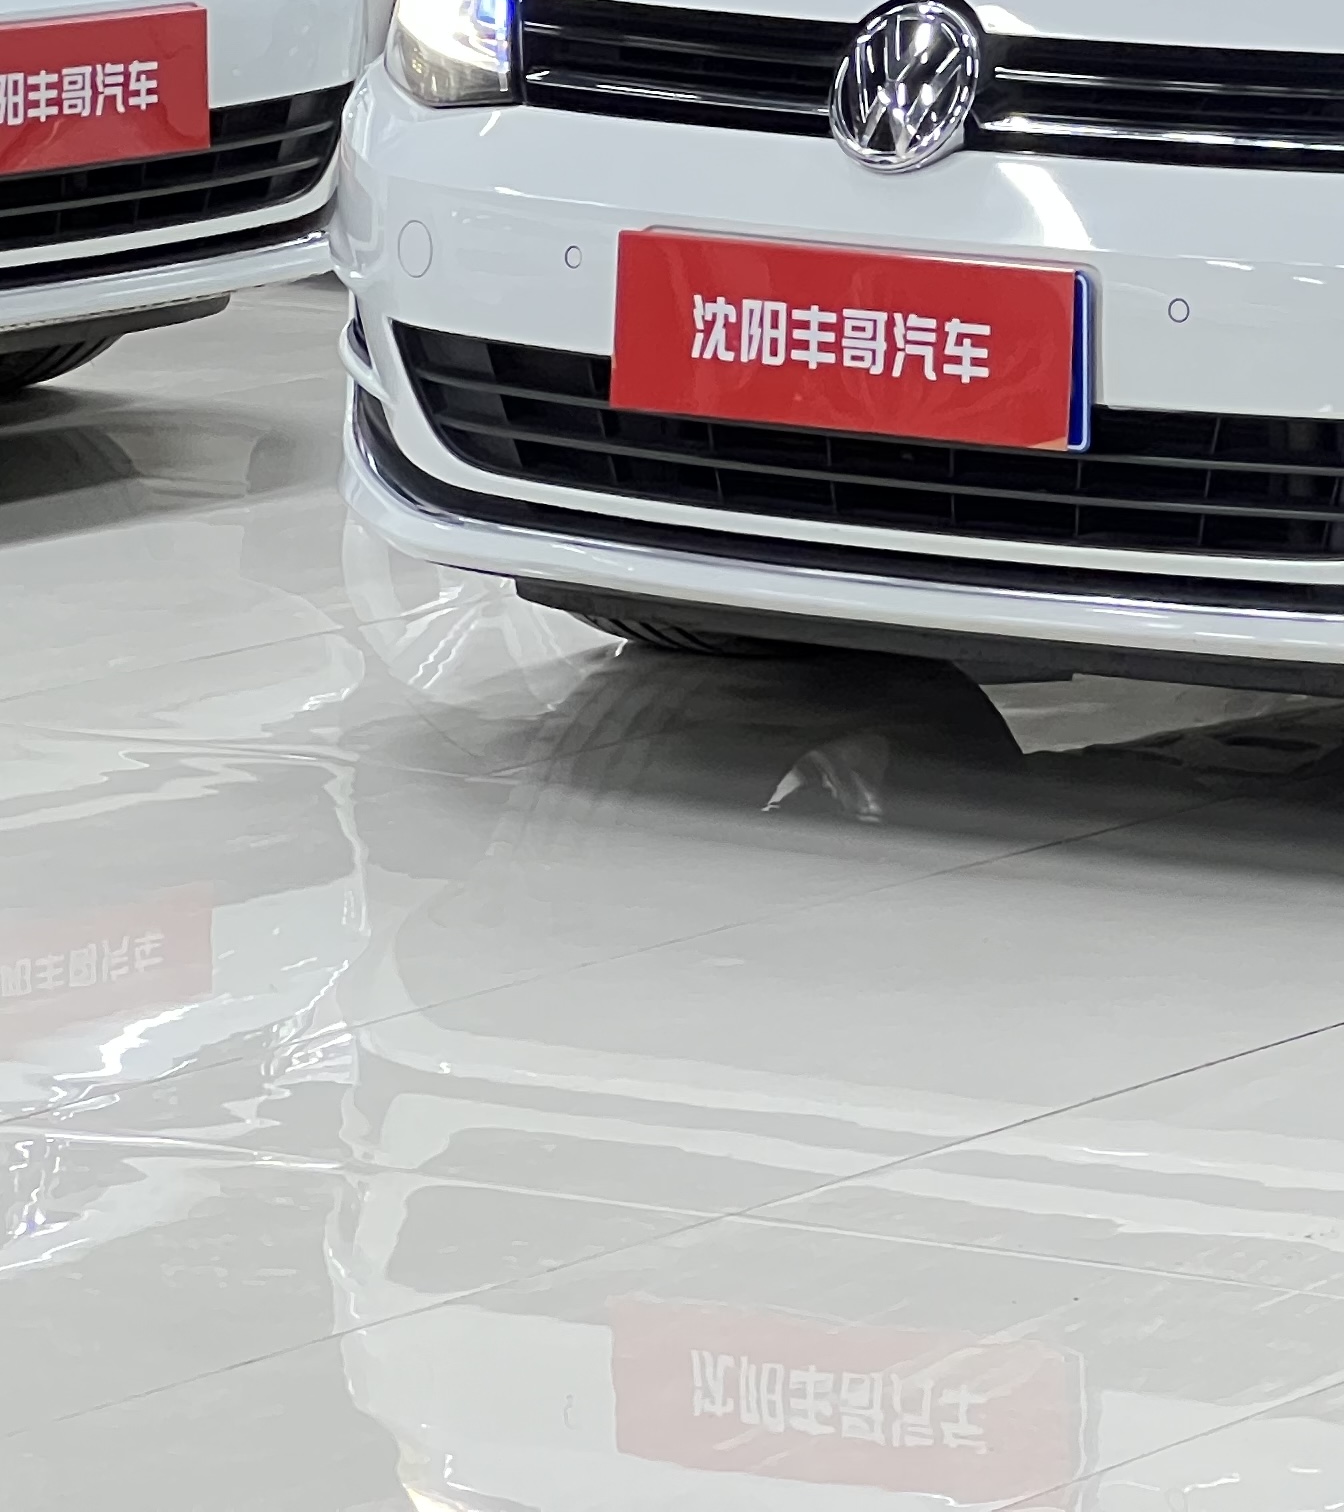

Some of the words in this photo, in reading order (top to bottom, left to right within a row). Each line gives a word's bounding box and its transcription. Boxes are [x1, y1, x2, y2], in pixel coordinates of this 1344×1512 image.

[691, 294, 990, 384] 沈阳丰哥汽车
